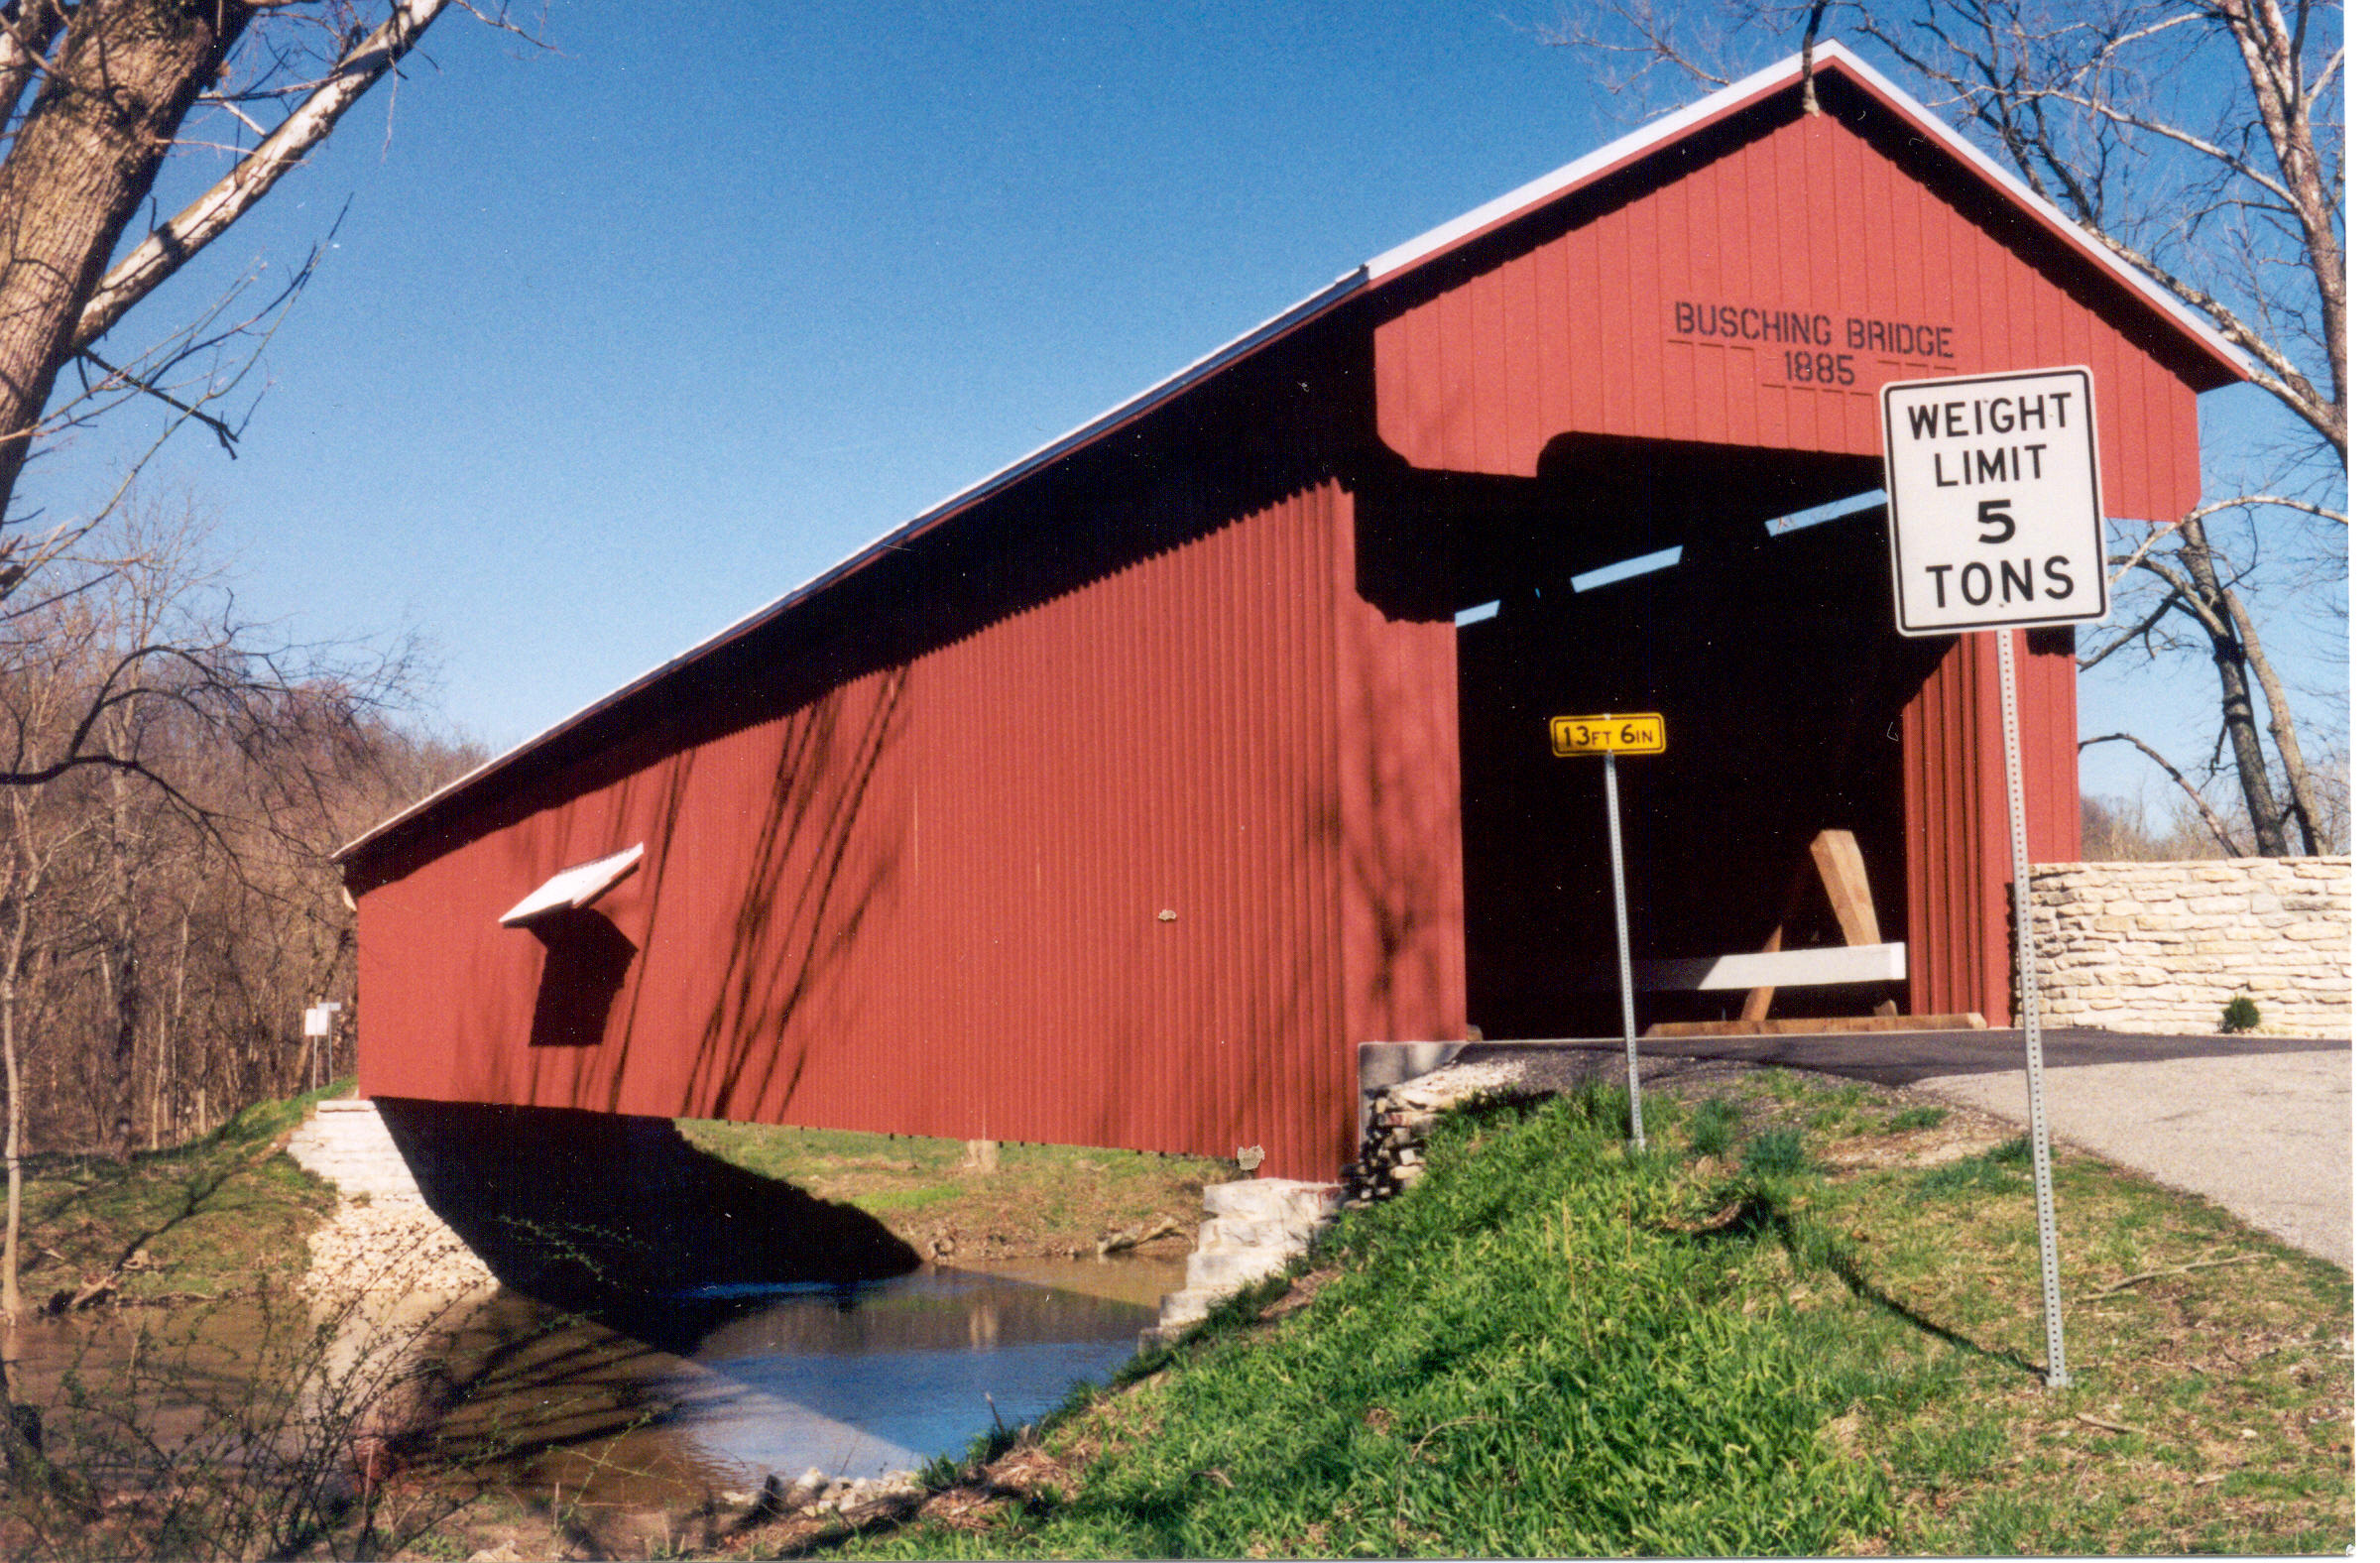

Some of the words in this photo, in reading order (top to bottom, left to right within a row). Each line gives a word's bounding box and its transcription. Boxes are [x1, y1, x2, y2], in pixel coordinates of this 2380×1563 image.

[1674, 301, 1832, 347] BUSCHING
[1846, 317, 1955, 358] BRIDGE
[1784, 350, 1855, 386] 1885
[1907, 392, 2072, 440] WEIGHT
[1935, 444, 2047, 487] LIMIT
[1977, 499, 2016, 544] 5
[1925, 555, 2075, 608] TONS
[1564, 725, 1611, 747] 13FT
[1620, 724, 1653, 744] 6IN
